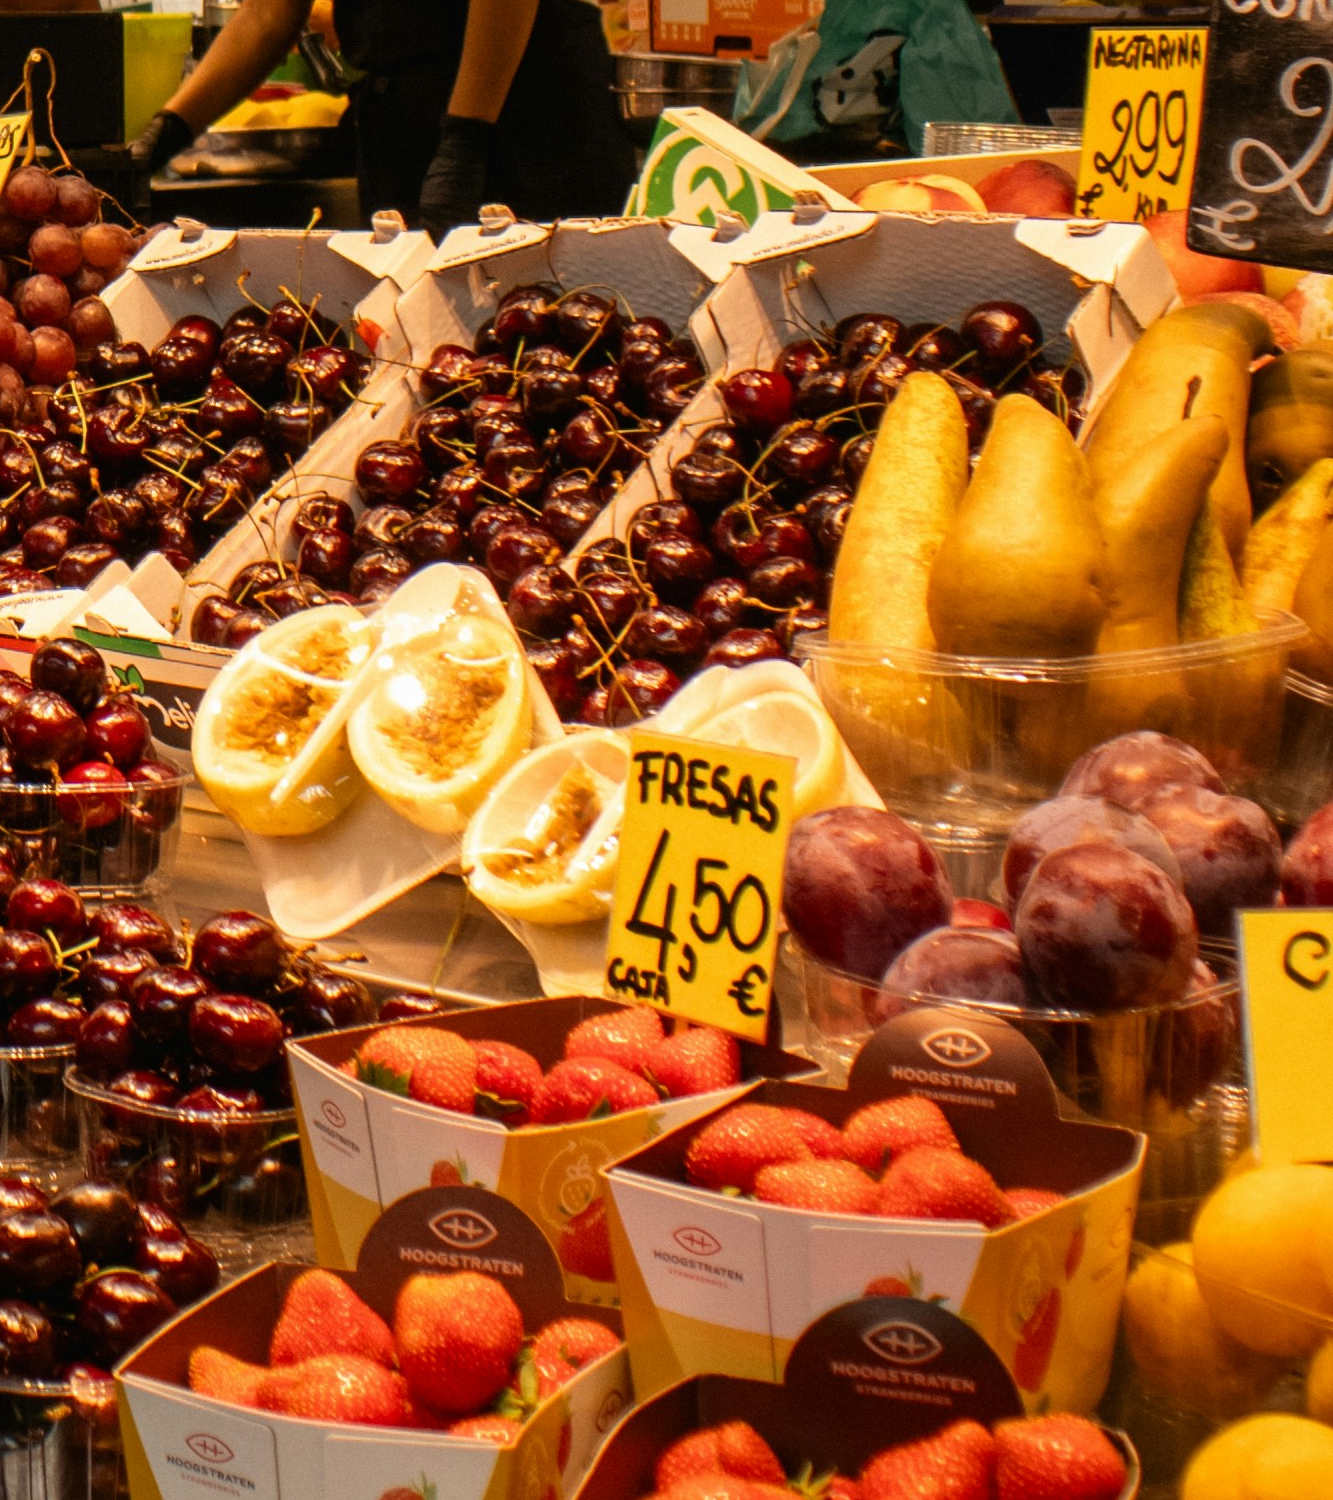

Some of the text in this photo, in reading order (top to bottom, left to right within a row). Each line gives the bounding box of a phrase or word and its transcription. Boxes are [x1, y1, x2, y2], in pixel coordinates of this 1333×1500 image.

[633, 750, 780, 833] FRESAS
[607, 957, 671, 1006] CAJA
[890, 1064, 1018, 1096] HOOGSTRATEN
[399, 1247, 525, 1277] HOOGSTRATEN
[653, 1249, 744, 1282] HOOGSTRATEN
[831, 1361, 976, 1394] HOOGSTRATEN
[165, 1454, 256, 1490] HOOGSTRATEN
